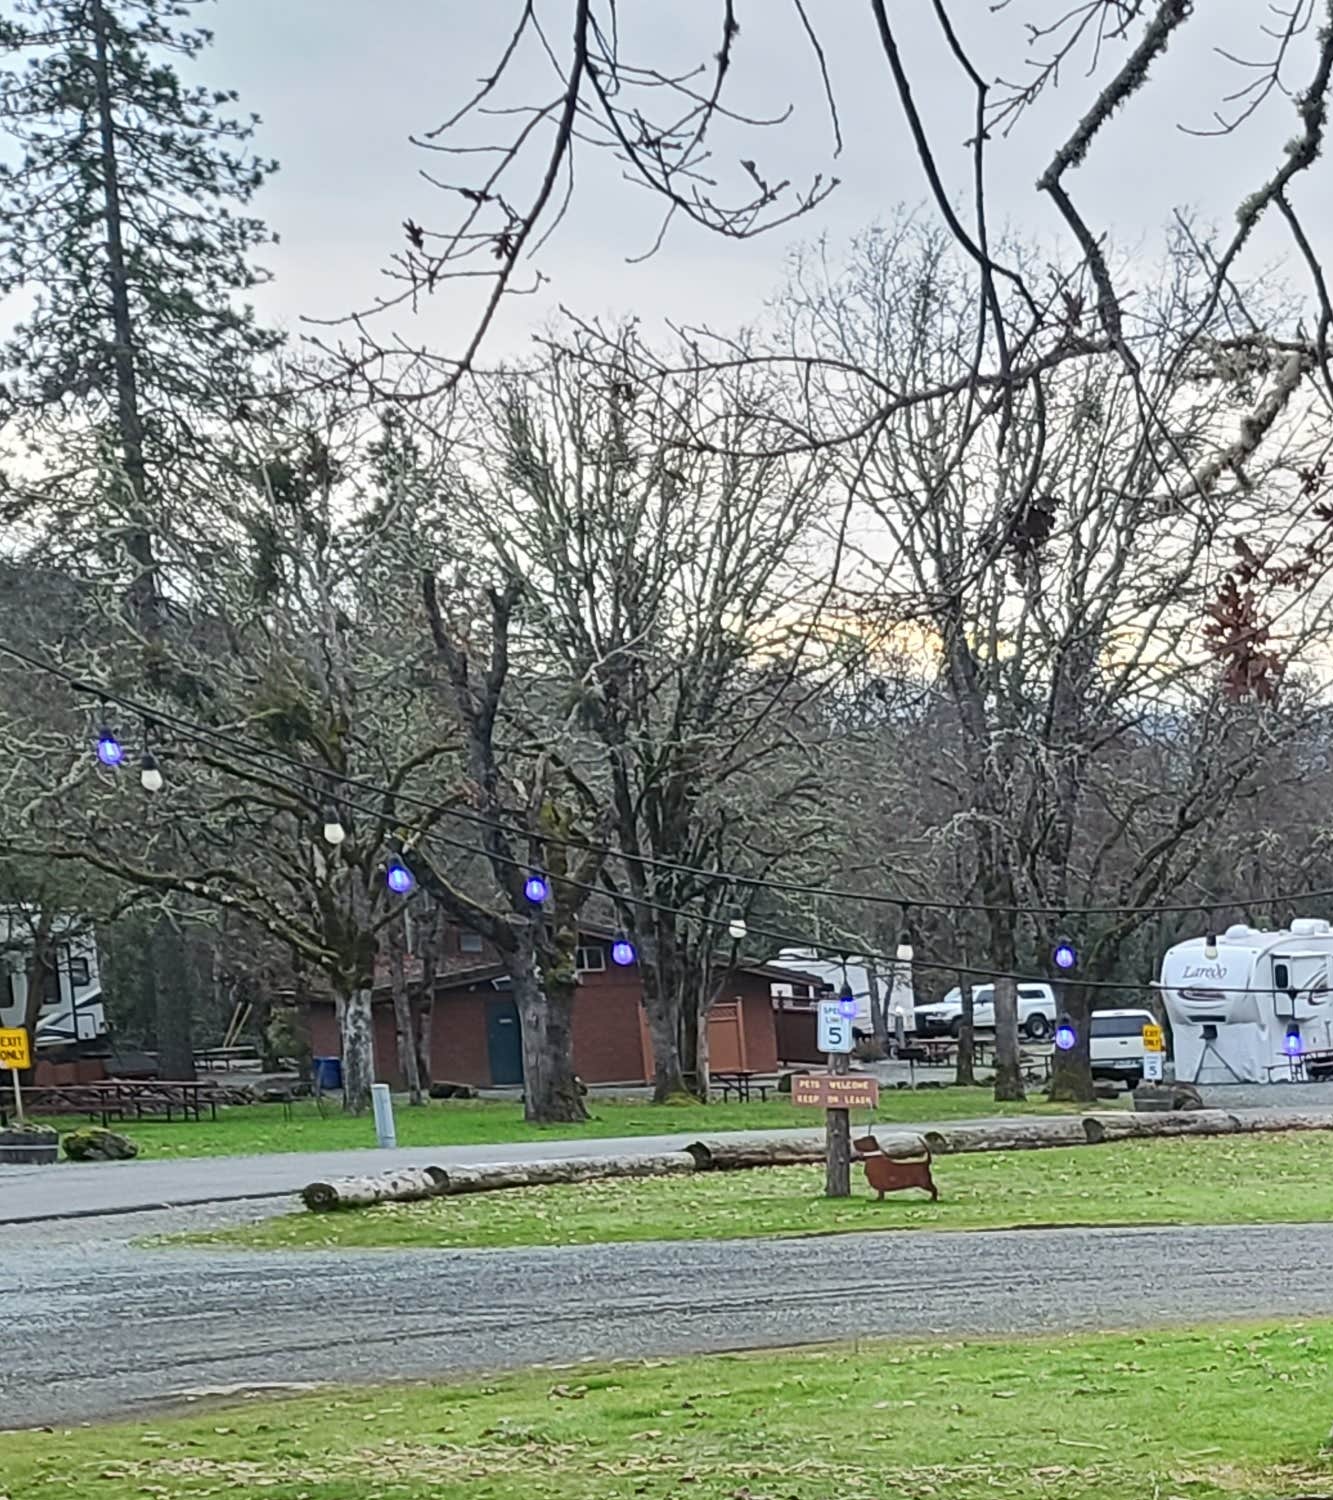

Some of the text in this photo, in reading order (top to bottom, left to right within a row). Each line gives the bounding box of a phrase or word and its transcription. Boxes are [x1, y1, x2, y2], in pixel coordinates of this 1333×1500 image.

[1182, 963, 1228, 979] Laredo
[0, 1036, 22, 1047] EXIT
[828, 1027, 842, 1045] 5
[0, 1050, 24, 1060] ONLY
[1149, 1065, 1158, 1076] 5
[799, 1080, 869, 1090] PETS WELCOME
[797, 1094, 872, 1105] KEEP ON LEASH
